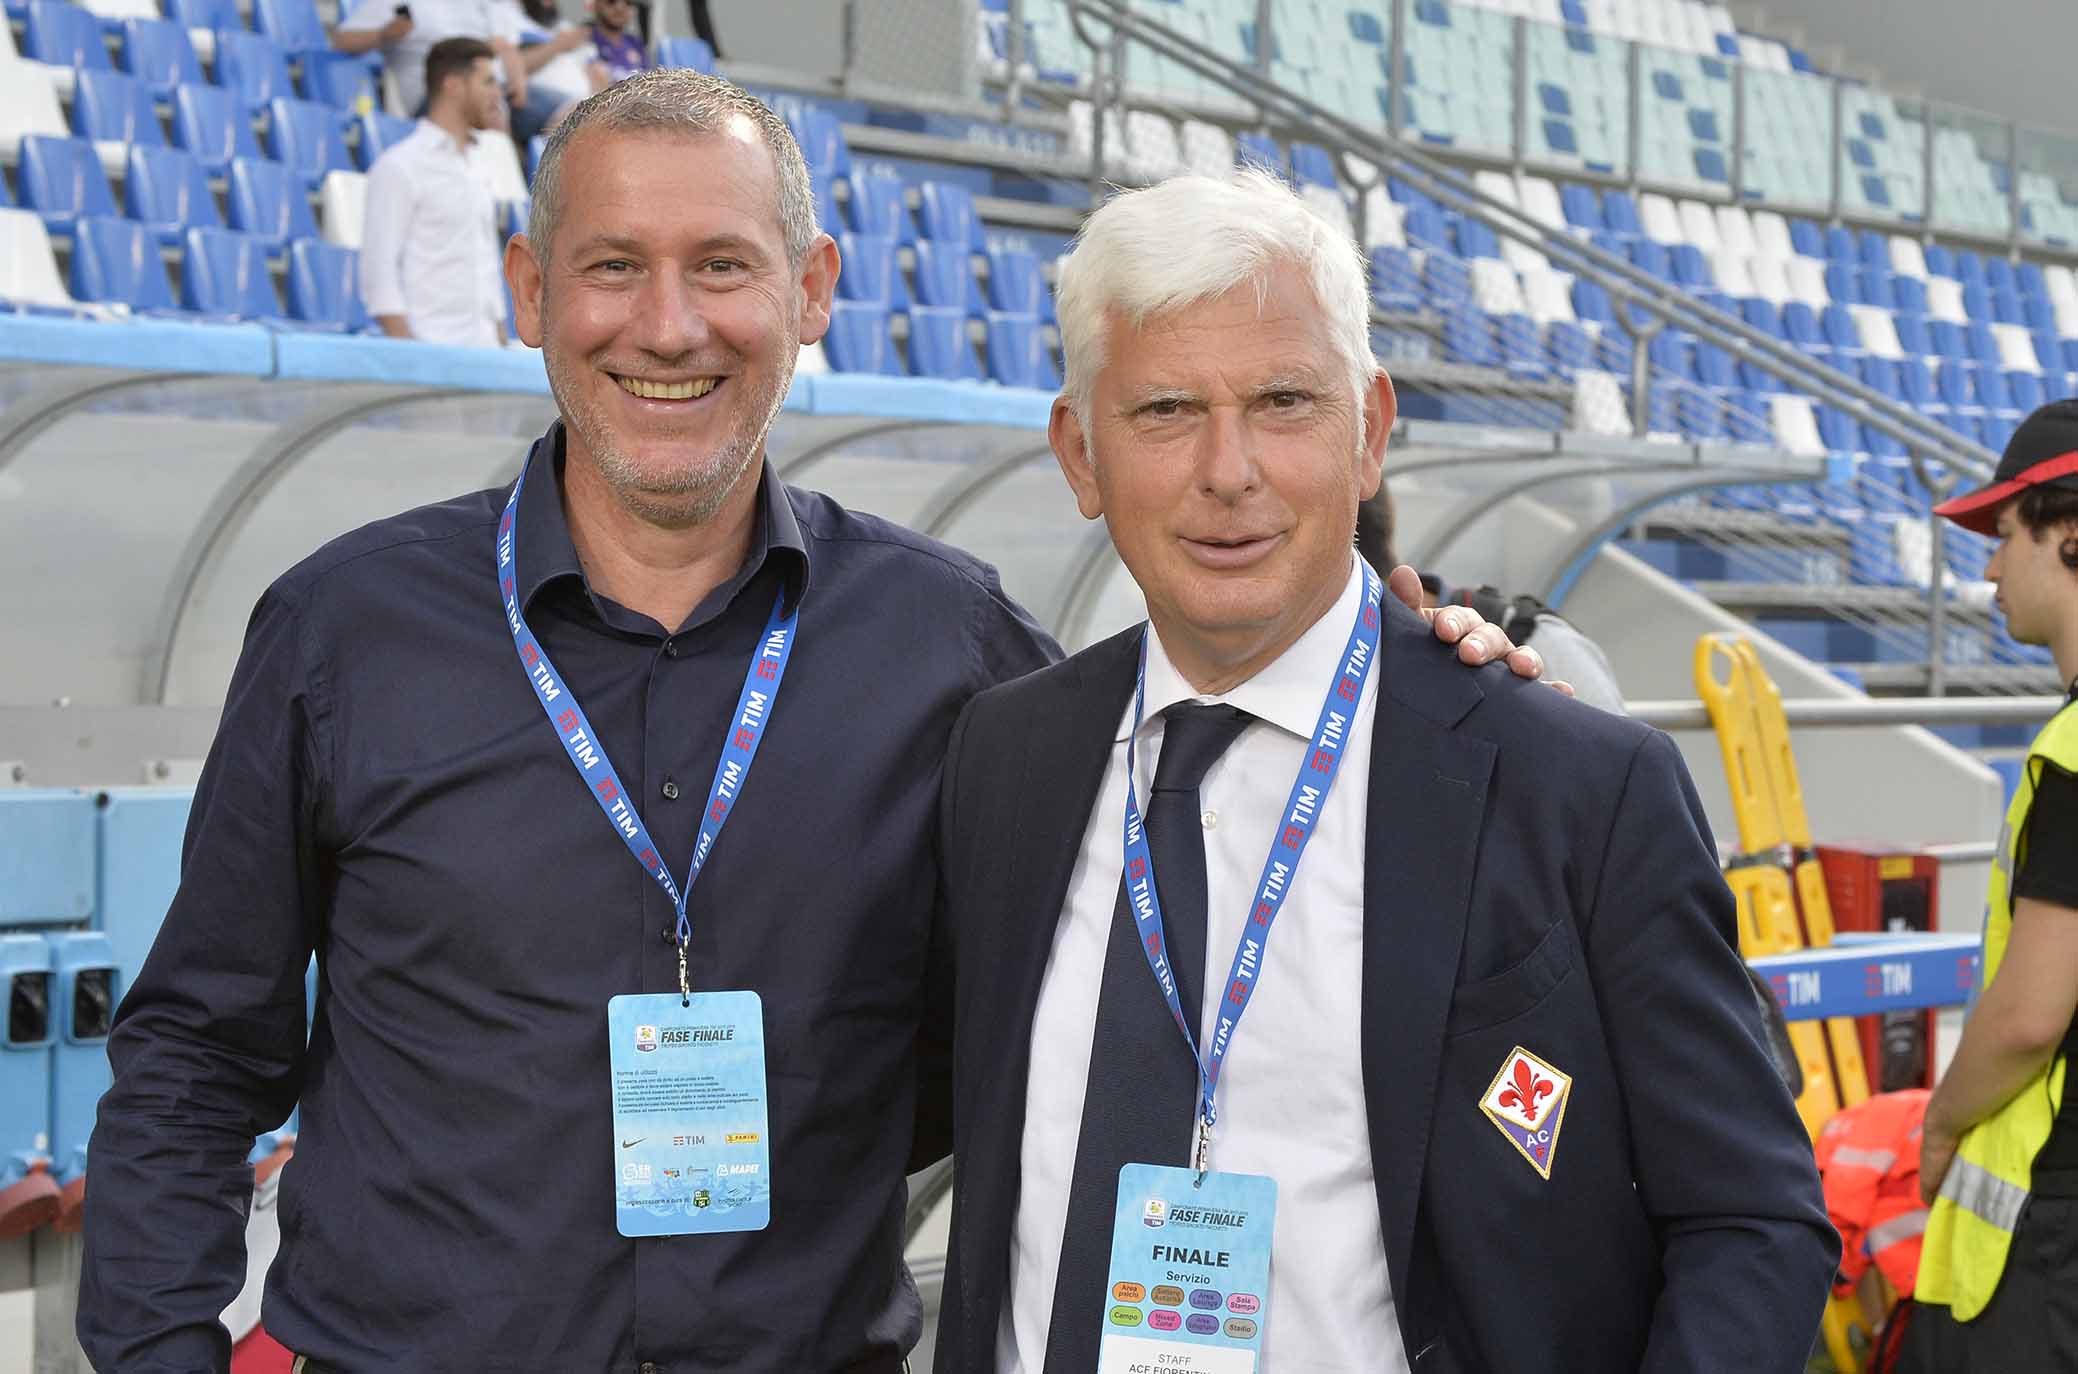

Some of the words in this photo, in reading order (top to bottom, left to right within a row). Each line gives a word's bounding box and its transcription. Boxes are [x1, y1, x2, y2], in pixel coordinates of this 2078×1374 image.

[500, 531, 510, 567] TIM
[508, 595, 521, 634] TIM
[762, 629, 788, 657] TIM
[1345, 638, 1370, 677] TIM
[534, 662, 560, 701] TIM
[741, 691, 767, 727] TIM
[569, 727, 599, 769] TIM
[1319, 711, 1346, 749] TIM
[718, 761, 741, 798] TIM
[612, 798, 638, 838] TIM
[1290, 784, 1320, 824] TIM
[694, 832, 711, 869] TIM
[658, 868, 678, 904] TIM
[1134, 878, 1153, 920] TIM
[1262, 861, 1289, 901] TIM
[1156, 955, 1172, 996] TIM
[1236, 938, 1260, 979] TIM
[1788, 972, 1820, 1005] TIM
[1882, 963, 1912, 996] TIM
[661, 1031, 690, 1043] FASE
[693, 1029, 734, 1042] FINALE
[1213, 1017, 1232, 1056] TIM
[685, 1136, 705, 1145] TIM
[1526, 1129, 1550, 1148] AC
[1169, 1208, 1200, 1223] FASE
[1202, 1212, 1246, 1228] FINALE
[1152, 1245, 1230, 1268] FINALE
[1166, 1270, 1211, 1285] Servizio
[1129, 1363, 1151, 1374] ACF
[1158, 1353, 1192, 1366] STAFF
